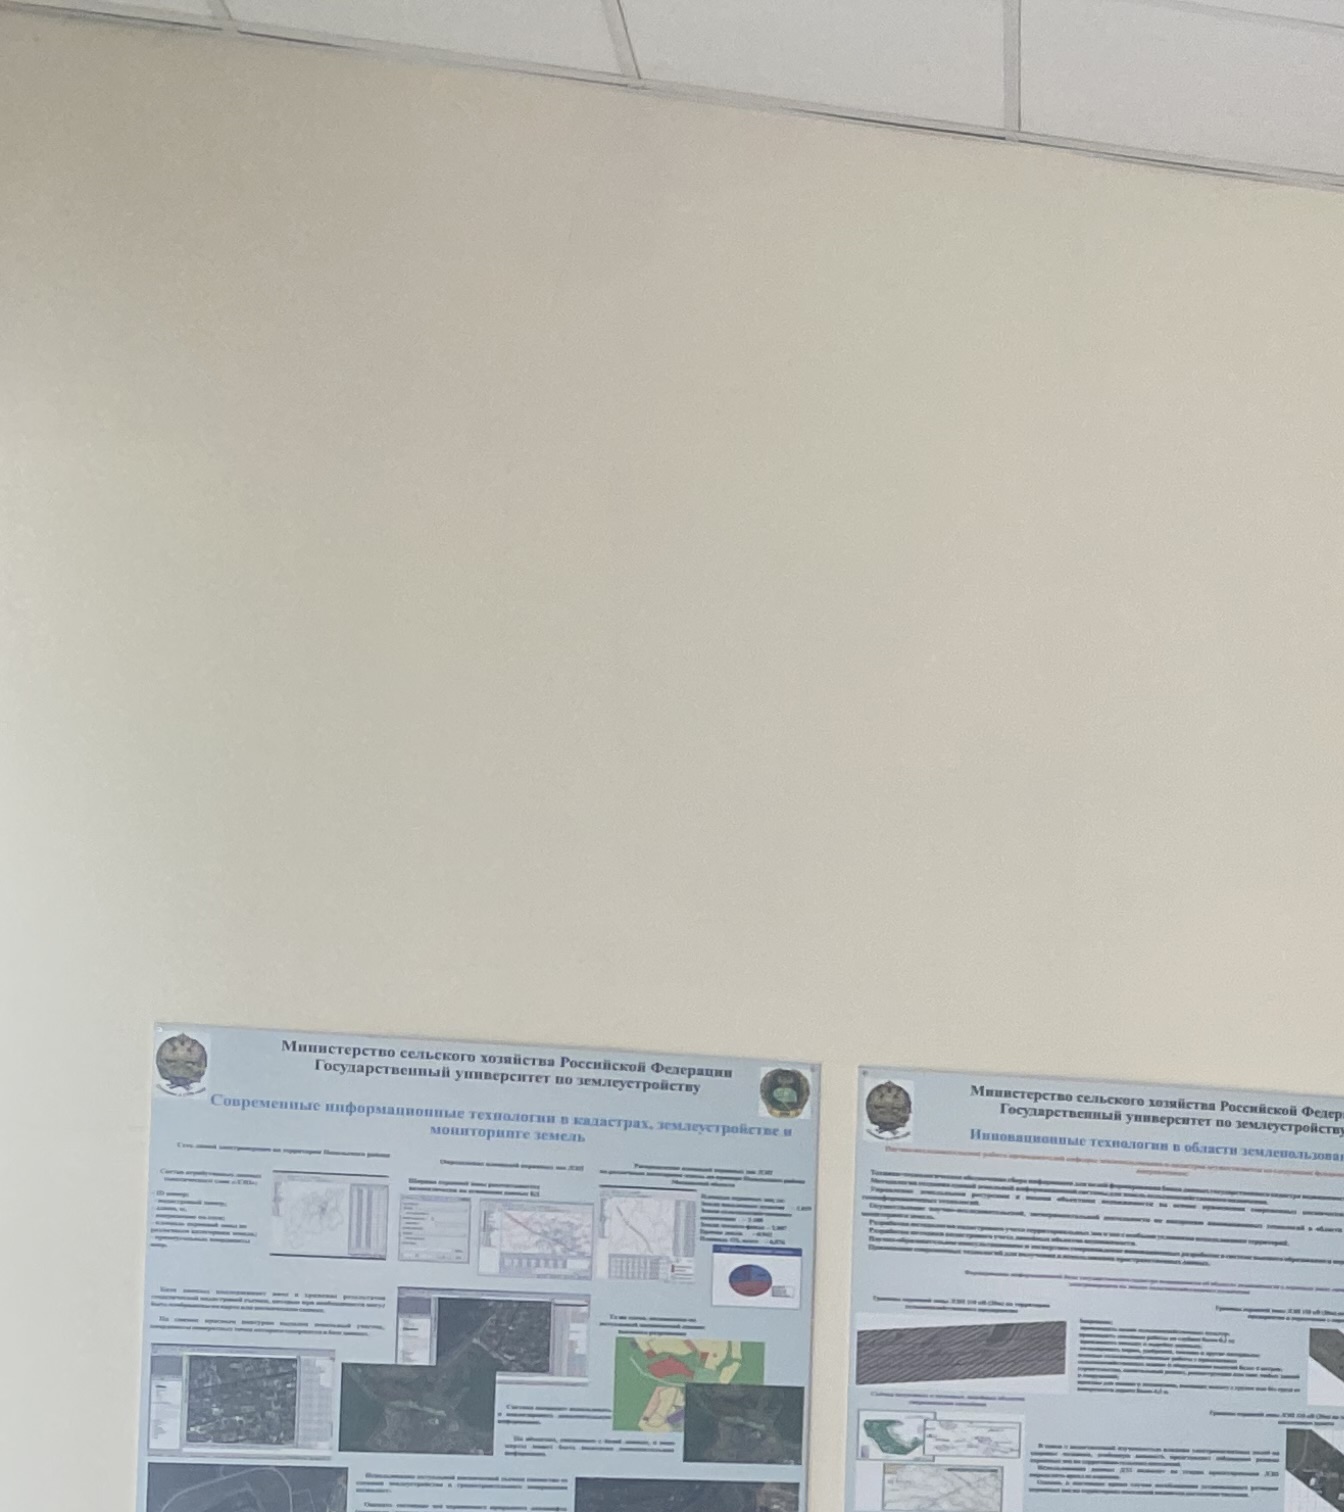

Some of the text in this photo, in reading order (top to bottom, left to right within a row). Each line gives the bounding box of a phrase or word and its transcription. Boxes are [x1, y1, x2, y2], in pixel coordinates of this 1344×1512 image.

[281, 1040, 733, 1079] Министерство сельского хозяйства Российской Федерации
[315, 1059, 701, 1095] Государственный университет по землеустройству
[210, 1093, 321, 1111] Современные
[325, 1101, 465, 1119] информационные
[468, 1110, 556, 1125] технологии
[560, 1117, 569, 1126] в
[657, 1120, 779, 1137] землеустройстве
[783, 1128, 792, 1137] и
[970, 1085, 1073, 1103] Министерство
[1076, 1093, 1145, 1107] сельского
[1148, 1097, 1216, 1112] хозяйства
[1220, 1100, 1298, 1116] Российской
[999, 1103, 1122, 1121] Государственный
[1125, 1111, 1212, 1127] университет
[1216, 1118, 1232, 1128] по
[430, 1123, 586, 1143] мониторинге земель
[970, 1128, 1085, 1146] Инновационные
[1090, 1138, 1169, 1151] технологии
[1173, 1144, 1180, 1152] в
[1184, 1141, 1238, 1156] области
